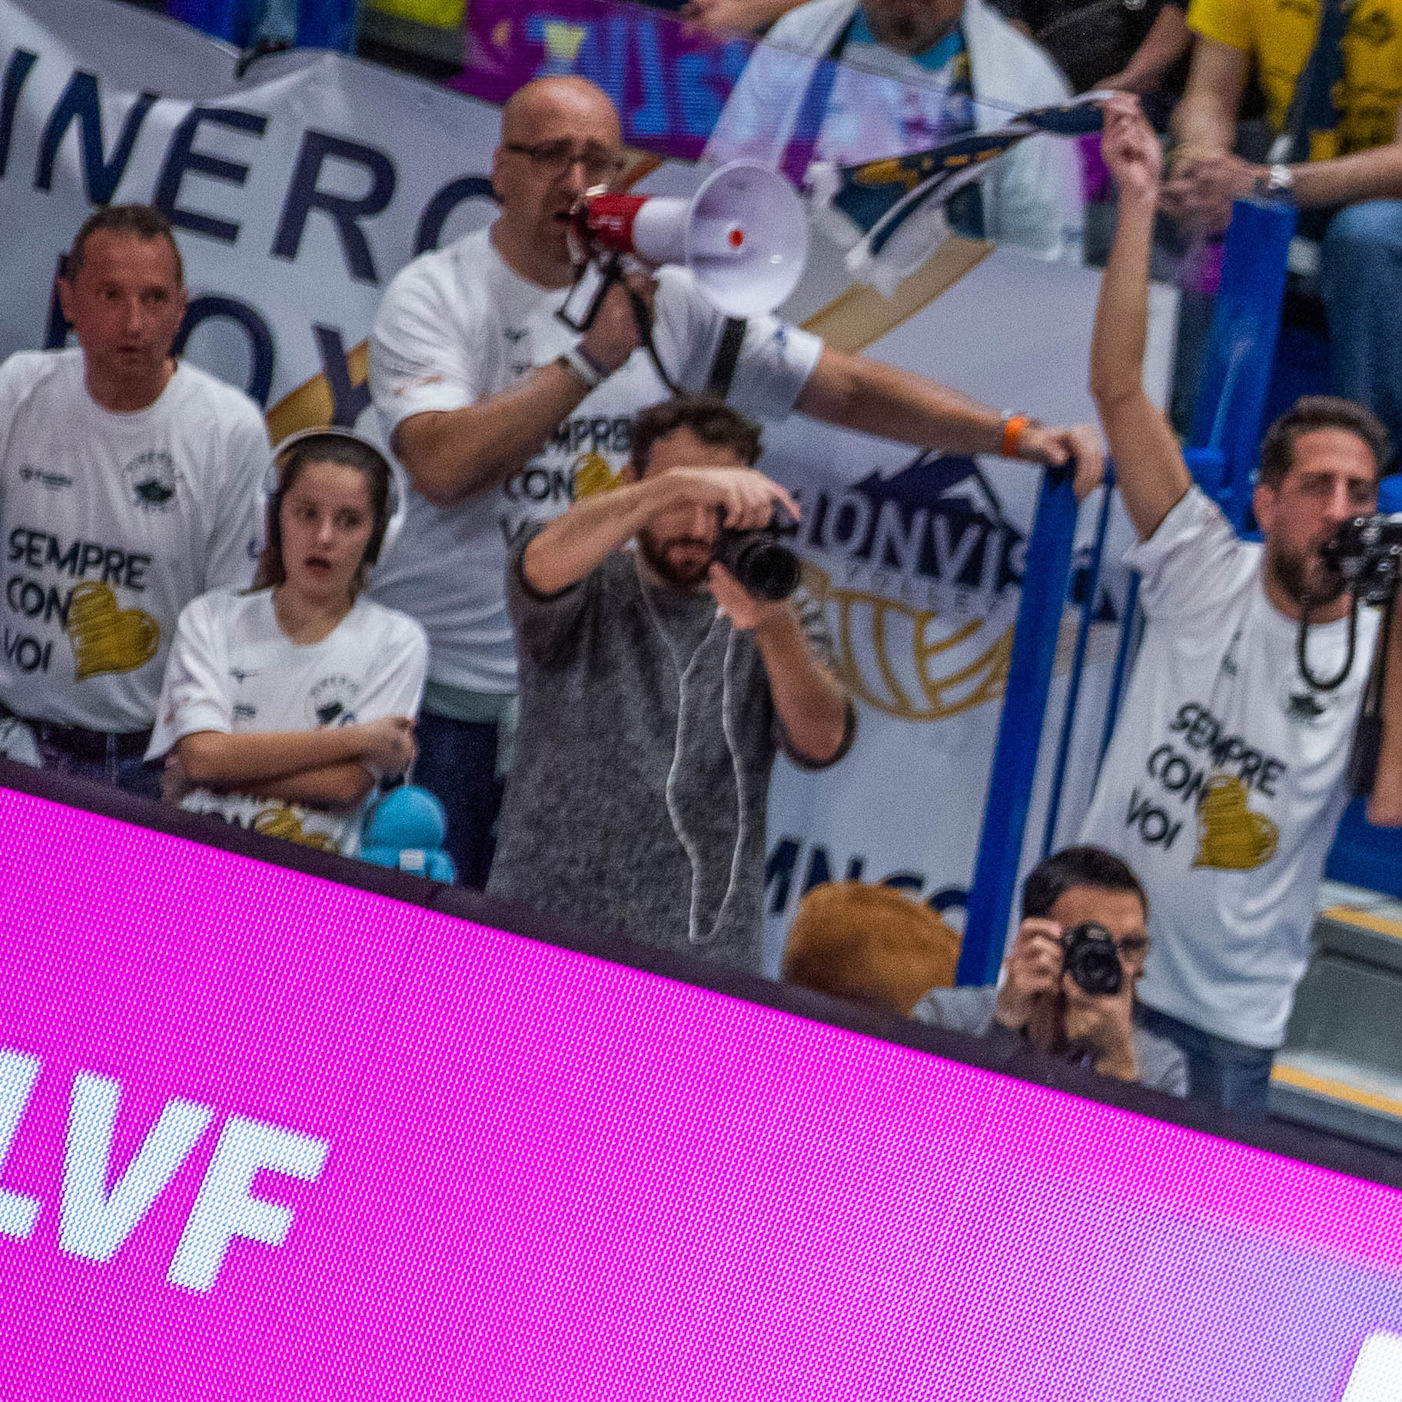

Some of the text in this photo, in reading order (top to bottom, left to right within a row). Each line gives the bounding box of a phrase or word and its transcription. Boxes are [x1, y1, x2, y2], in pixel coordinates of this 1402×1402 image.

[7, 527, 152, 592] SEMPRE
[5, 574, 73, 632] CON
[1, 627, 53, 674] VOI
[1147, 743, 1210, 806] CON
[1169, 702, 1287, 797] SEMPRE
[1125, 785, 1183, 850] VOI
